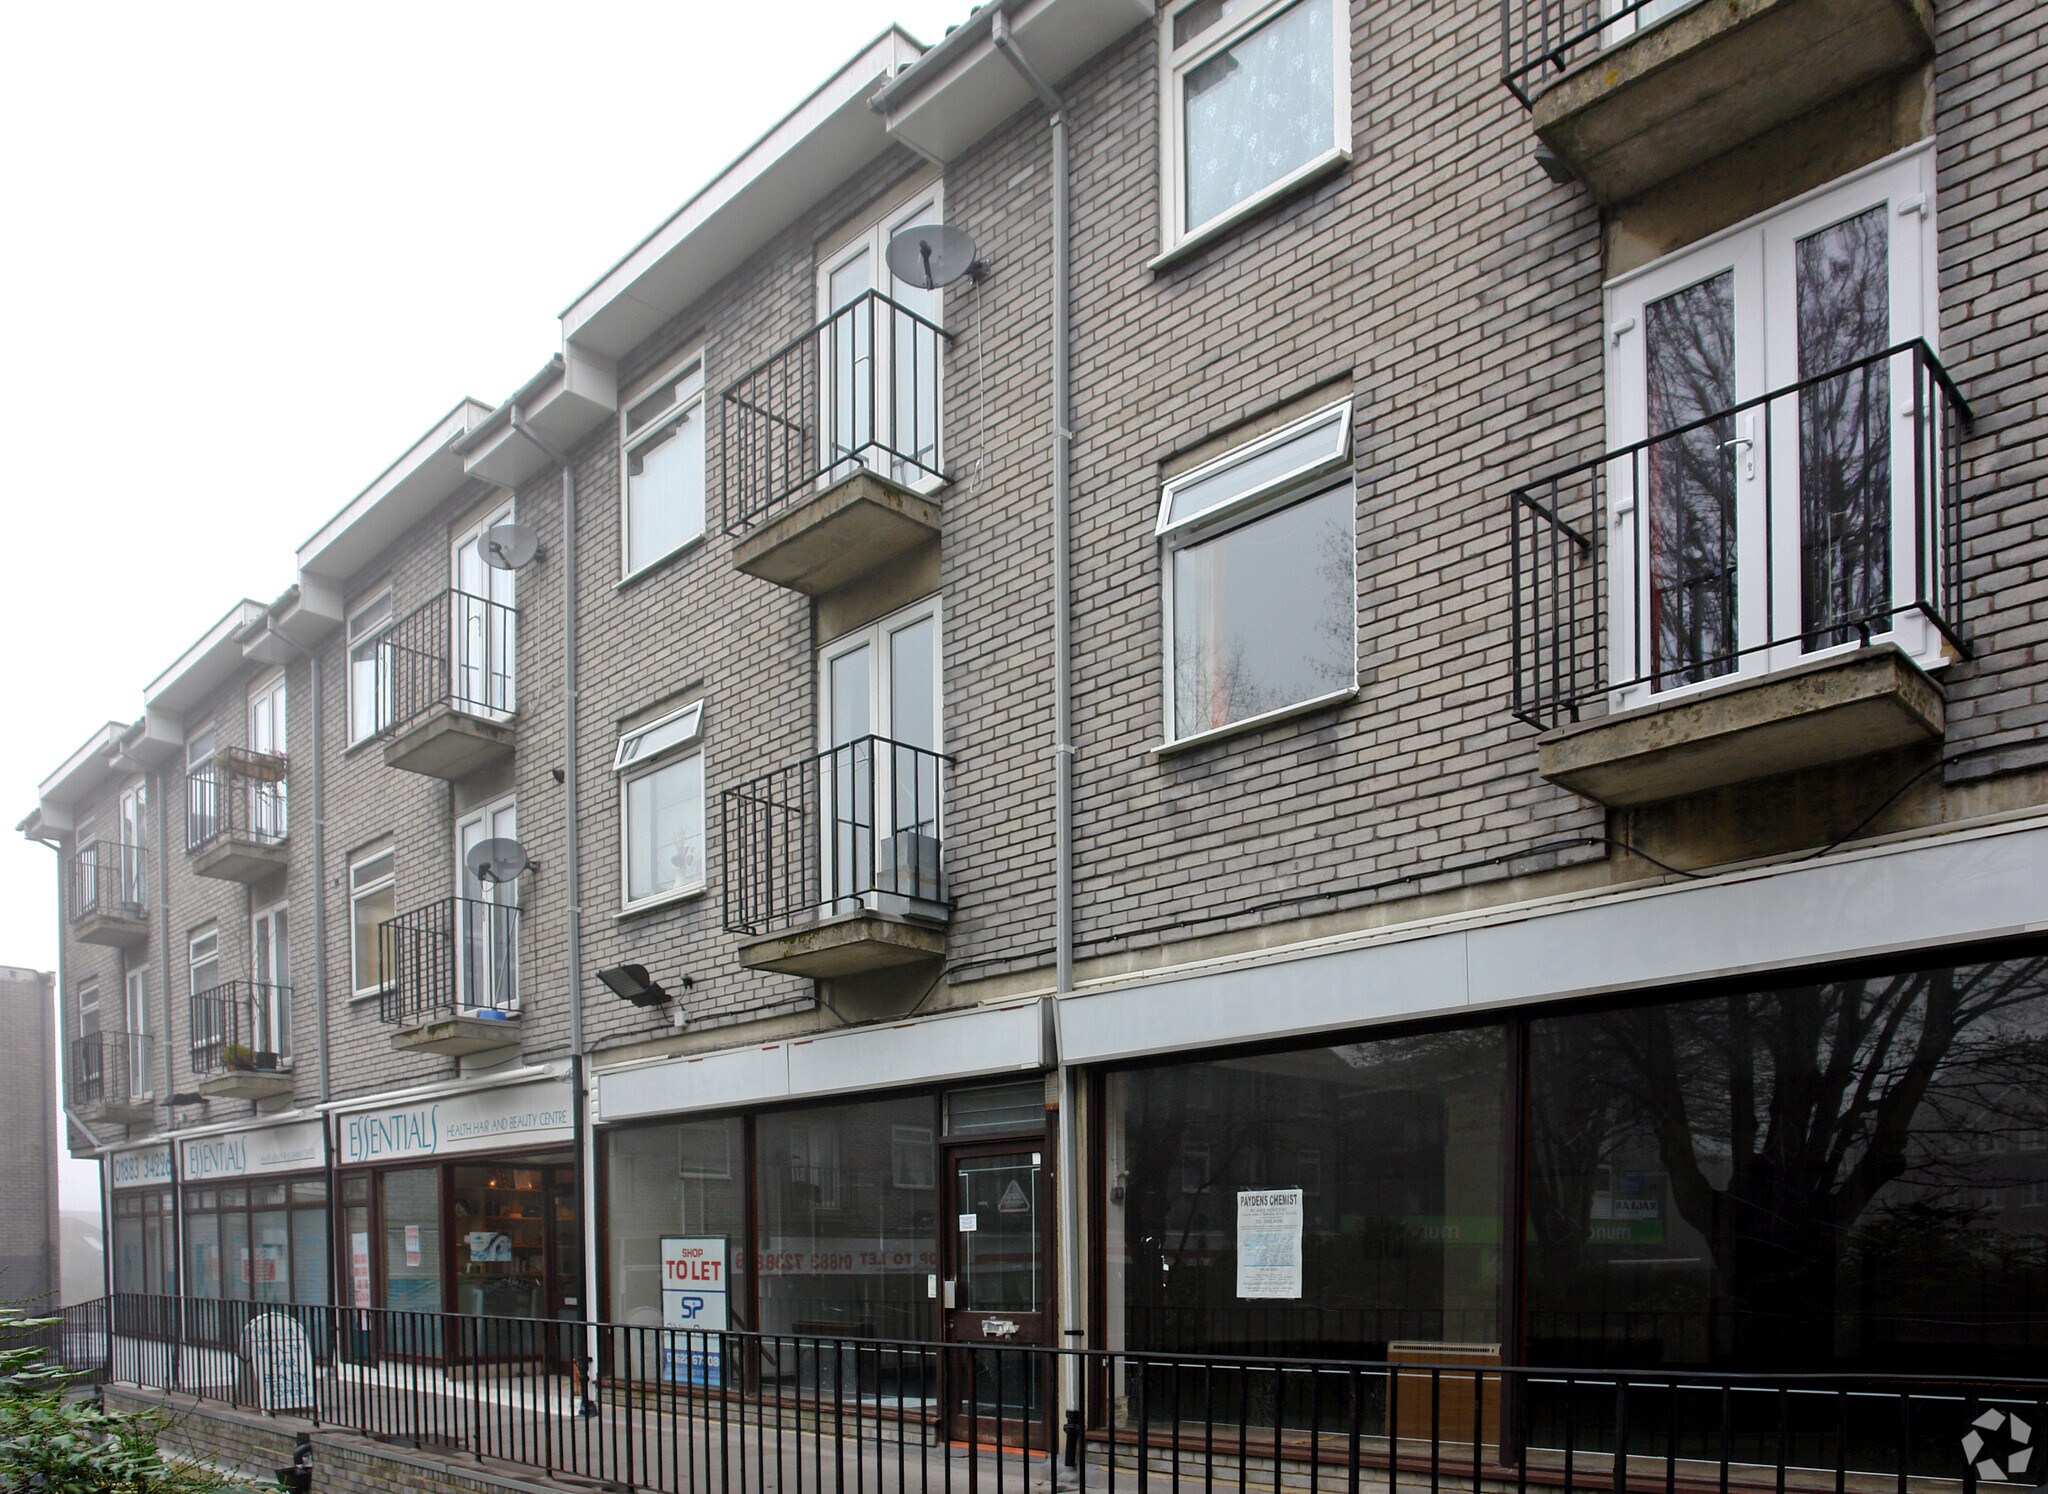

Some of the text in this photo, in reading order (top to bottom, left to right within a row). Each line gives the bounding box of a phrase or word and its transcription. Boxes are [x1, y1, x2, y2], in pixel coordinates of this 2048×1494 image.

[349, 1104, 439, 1162] ESSENTIALS
[446, 1110, 567, 1137] HEALTH HAIR AND BEAUTY CENTRE
[115, 1156, 139, 1182] 01883
[190, 1135, 247, 1180] ESSENTALS
[1240, 1194, 1298, 1207] PAYDENS CHEMIST
[681, 1248, 704, 1258] SHOP
[666, 1260, 722, 1281] TO LET
